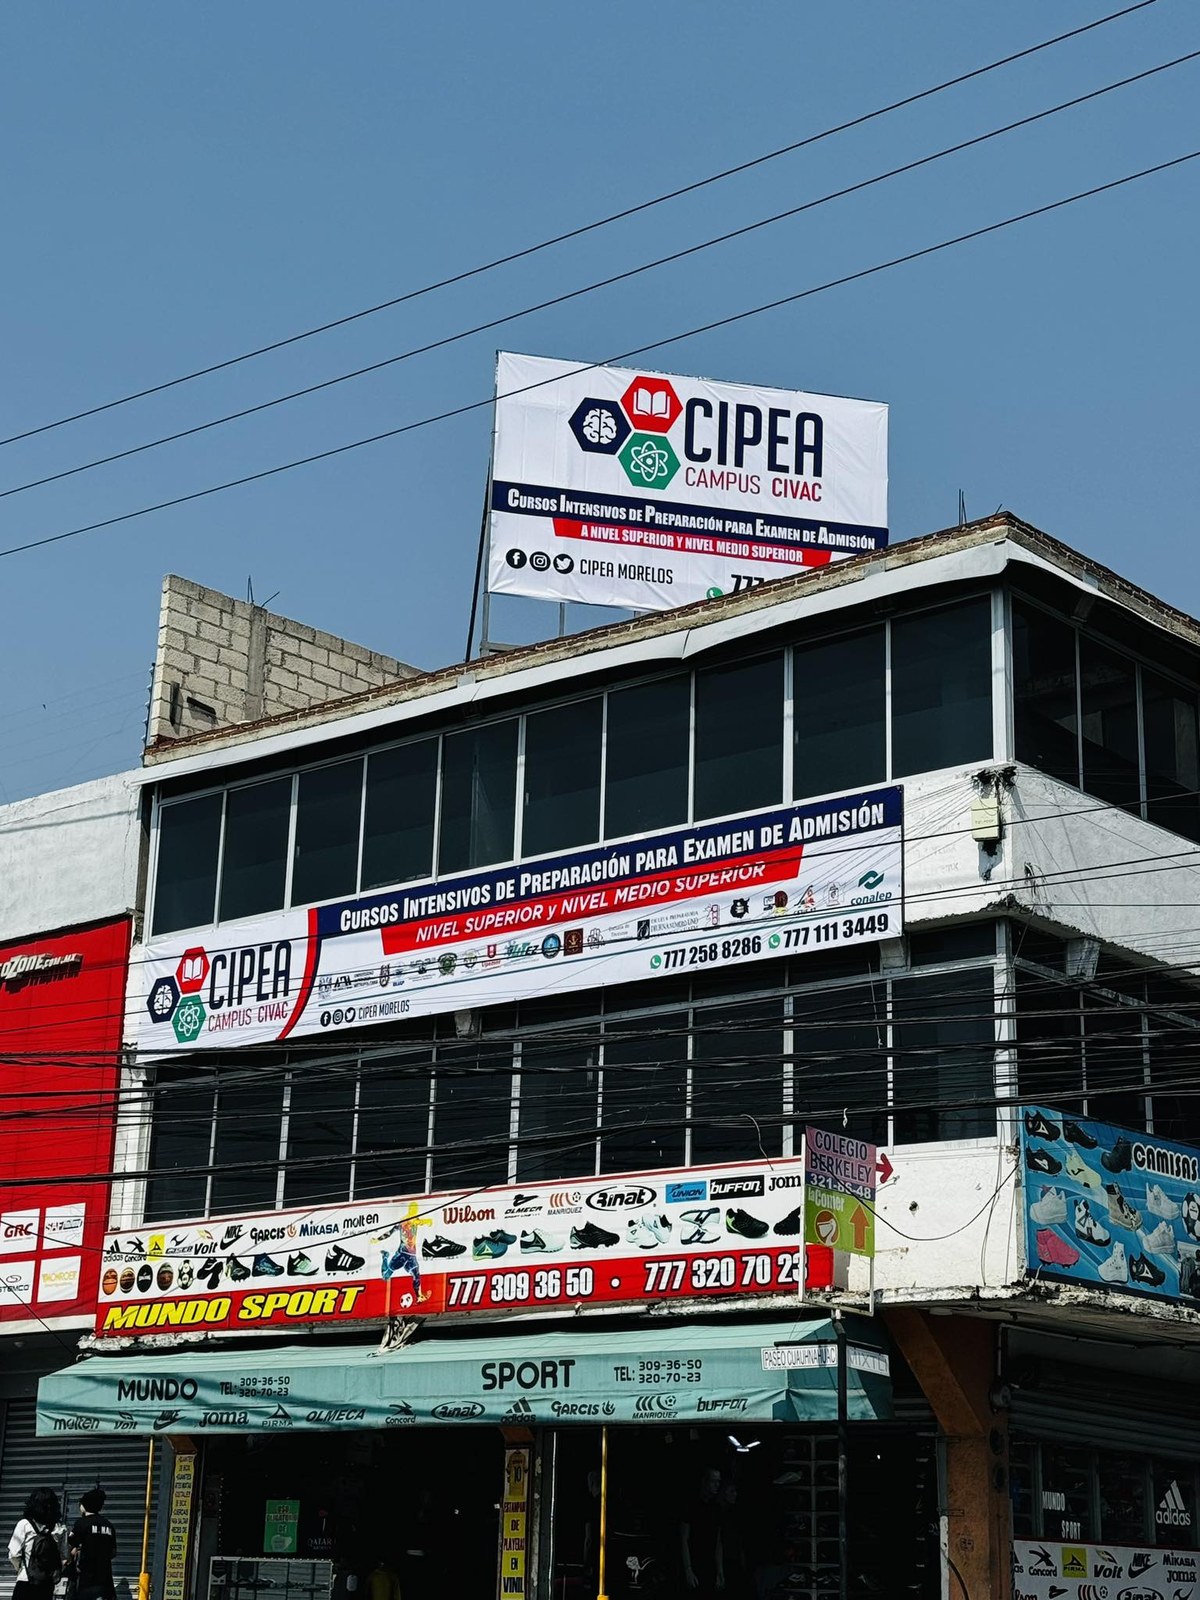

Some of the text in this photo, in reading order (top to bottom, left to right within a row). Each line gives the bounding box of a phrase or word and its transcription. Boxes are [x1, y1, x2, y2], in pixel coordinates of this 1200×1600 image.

[685, 397, 824, 478] CIPEA
[685, 467, 822, 502] CAMPUS CIVAC
[507, 489, 876, 550] CURSOS INTENSIVOS DE PREPARACIÓN PARA EXAMEN DE ADMISIÓN
[581, 525, 803, 563] A NIVEL SUPERIOR Y NIVEL MEDIO SUPERIOR
[580, 559, 673, 585] CIPEA MORELOS
[340, 800, 884, 932] CURSOS INTENSIVOS DE PREPARACIÓN PARA EXAMEN DE ADMISIÓN
[415, 862, 765, 943] NIVEL SUPERIOR y NIVEL MEDIO SUPERIOR
[850, 890, 892, 906] conalep
[784, 913, 889, 948] 777 111 3449
[663, 935, 762, 969] 777 258 8286
[209, 941, 293, 1010] CIPEA
[208, 1001, 289, 1032] CAMPUS CIVAC
[358, 1000, 410, 1020] CIPEA MORELOS
[815, 1131, 867, 1160] COLEGIO
[810, 1152, 872, 1183] BERKELEY
[1133, 1143, 1198, 1182] CAMISAS
[443, 1205, 495, 1225] Wilson
[504, 1206, 543, 1214] OLMECA
[547, 1207, 583, 1216] MANRIQUEZ
[299, 1221, 339, 1237] MIKASA
[343, 1213, 379, 1229] molten
[224, 1224, 243, 1239] NIKE
[250, 1228, 285, 1245] GARCIS
[124, 1252, 147, 1263] Concord
[194, 1242, 218, 1255] Voit
[645, 1260, 686, 1293] 777
[691, 1257, 736, 1289] 320
[741, 1255, 768, 1286] 70
[448, 1267, 594, 1305] 777 309 36 50
[103, 1286, 366, 1330] MUNDO SPORT
[765, 1347, 836, 1367] PASEO CUAUHNAHUAC
[481, 1359, 576, 1391] SPORT
[613, 1360, 702, 1382] TEL: 309-36-50
[638, 1372, 702, 1384] 320-70-23
[117, 1378, 198, 1401] MUNDO
[220, 1376, 290, 1396] TEL: 309-36-50
[239, 1387, 289, 1397] 320-70-23
[305, 1408, 366, 1423] OLMECA
[501, 1412, 536, 1424] adidas
[551, 1400, 600, 1416] GARCIS
[632, 1411, 678, 1419] MANRIQUEZ
[53, 1416, 100, 1431] molten
[386, 1413, 417, 1425] Concord
[514, 1466, 522, 1483] 10
[1042, 1490, 1066, 1512] MUNDO
[511, 1519, 520, 1531] DE
[1155, 1510, 1191, 1526] adidas
[1061, 1520, 1081, 1540] SPORT
[1132, 1553, 1152, 1567] NIKE
[1028, 1566, 1057, 1577] Concord
[1093, 1564, 1123, 1579] Voit
